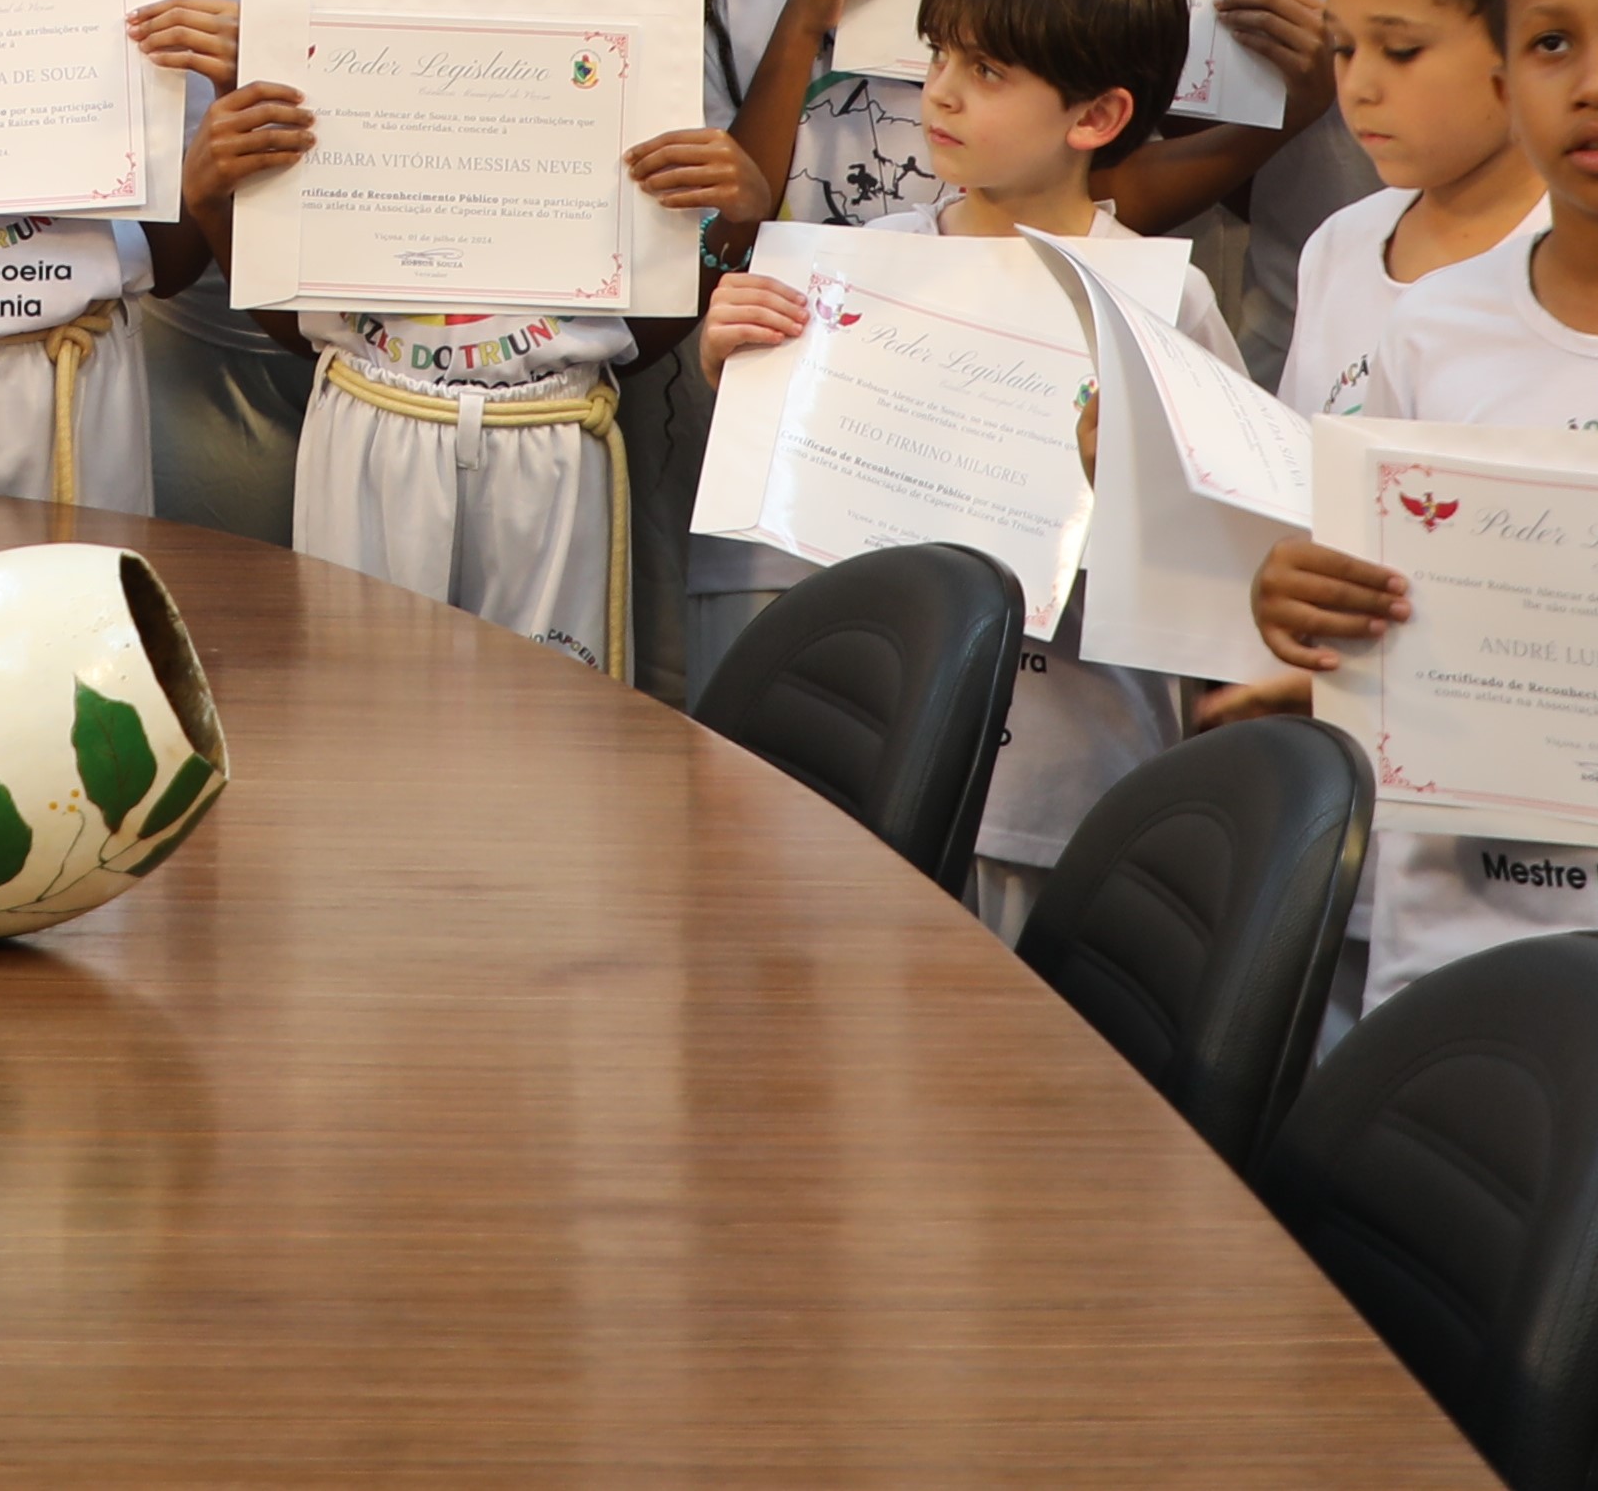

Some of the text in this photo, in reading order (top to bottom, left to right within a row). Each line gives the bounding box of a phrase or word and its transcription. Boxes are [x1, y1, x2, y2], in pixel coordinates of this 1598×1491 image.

[13, 69, 36, 84] DE
[41, 66, 98, 82] SOUZA
[382, 153, 452, 169] VITÓRIA
[458, 157, 530, 172] MESSIAS
[537, 160, 592, 174] NEVES
[840, 415, 1028, 487] THÉO FIRMINO MILAGRES
[1479, 636, 1558, 662] ANDRÉ
[1482, 852, 1587, 892] Mestre
